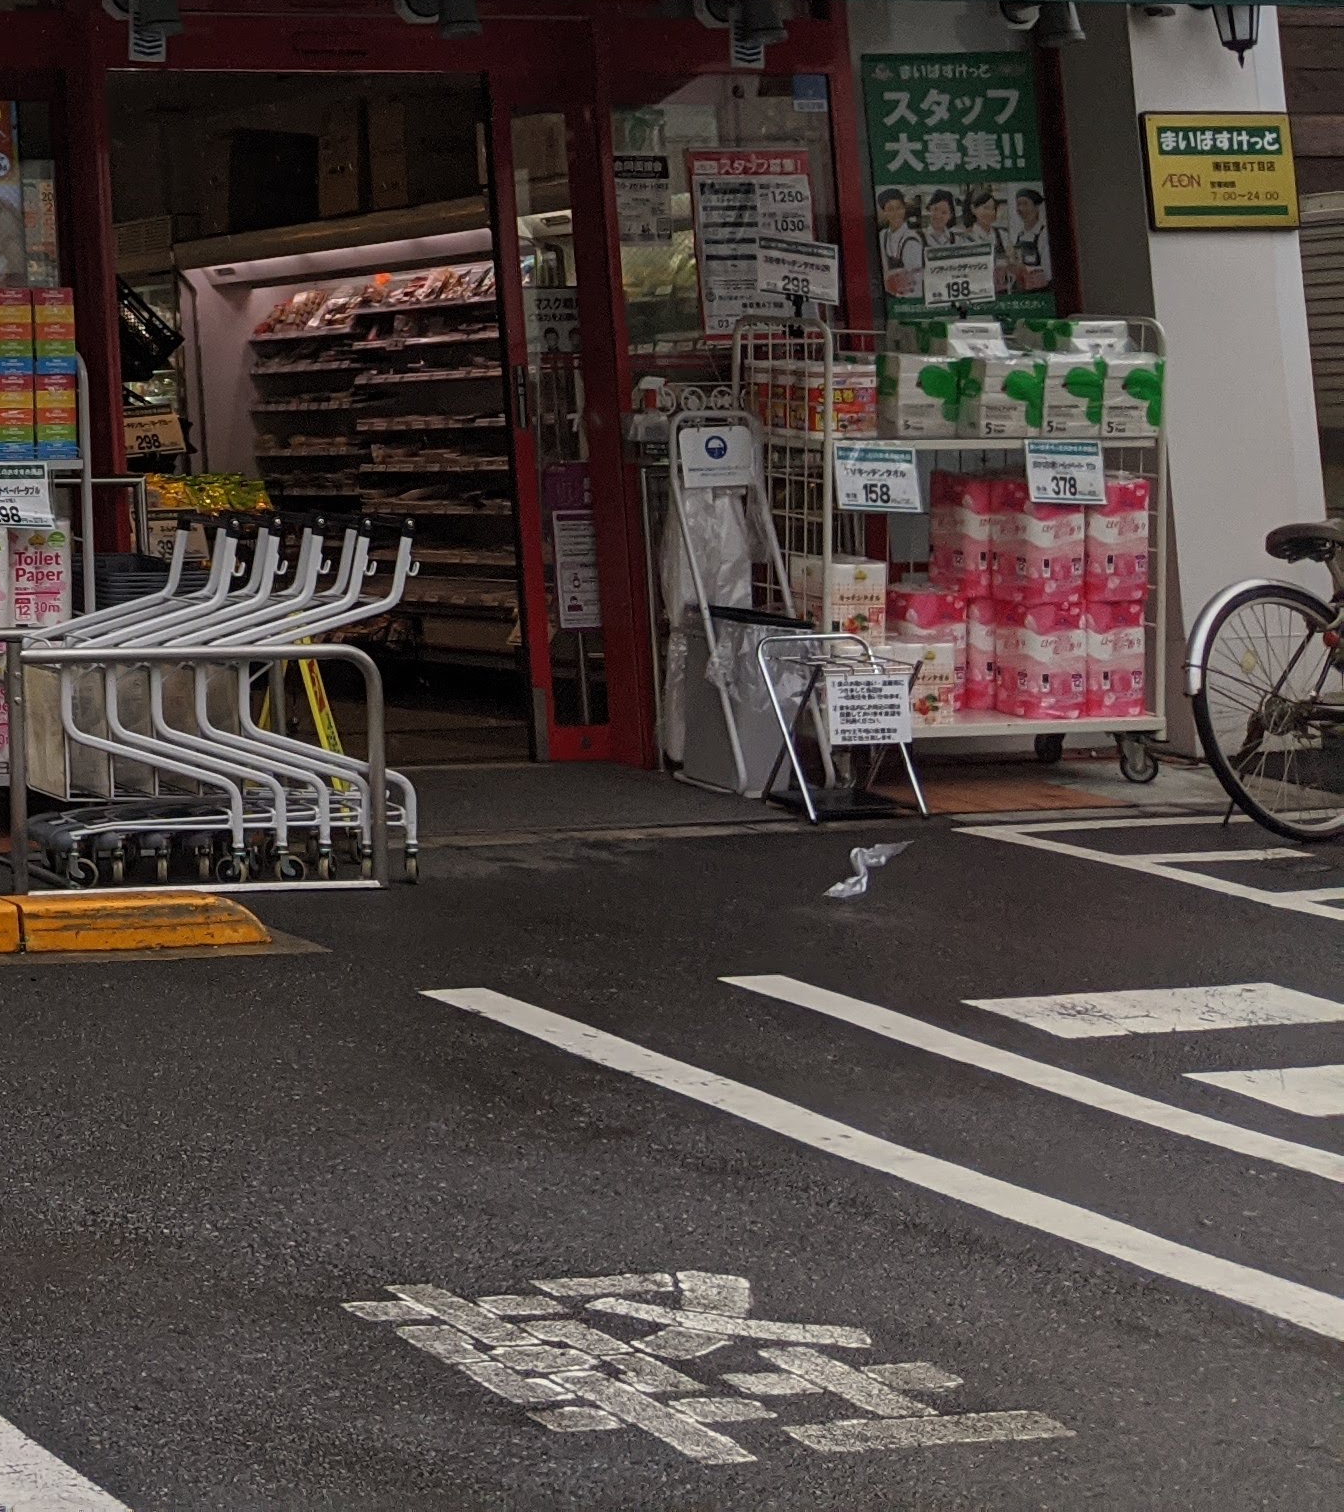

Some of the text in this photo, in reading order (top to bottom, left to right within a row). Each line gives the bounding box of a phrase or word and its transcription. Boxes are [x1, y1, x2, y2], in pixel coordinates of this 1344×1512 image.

[899, 64, 992, 79] まいばすけっと
[883, 89, 1020, 126] スタッフ
[1160, 131, 1279, 150] まいばすけっと
[885, 132, 1026, 172] 大募集!!
[782, 275, 811, 295] 298
[945, 280, 972, 299] 198
[985, 422, 993, 434] 5
[1047, 420, 1055, 433] 5
[1106, 421, 1115, 434] 5
[135, 433, 162, 451] 298
[862, 483, 891, 504] 158
[1050, 475, 1078, 496] 378
[14, 551, 61, 567] Toilet
[15, 567, 64, 585] Paper
[17, 602, 61, 616] 12 30m
